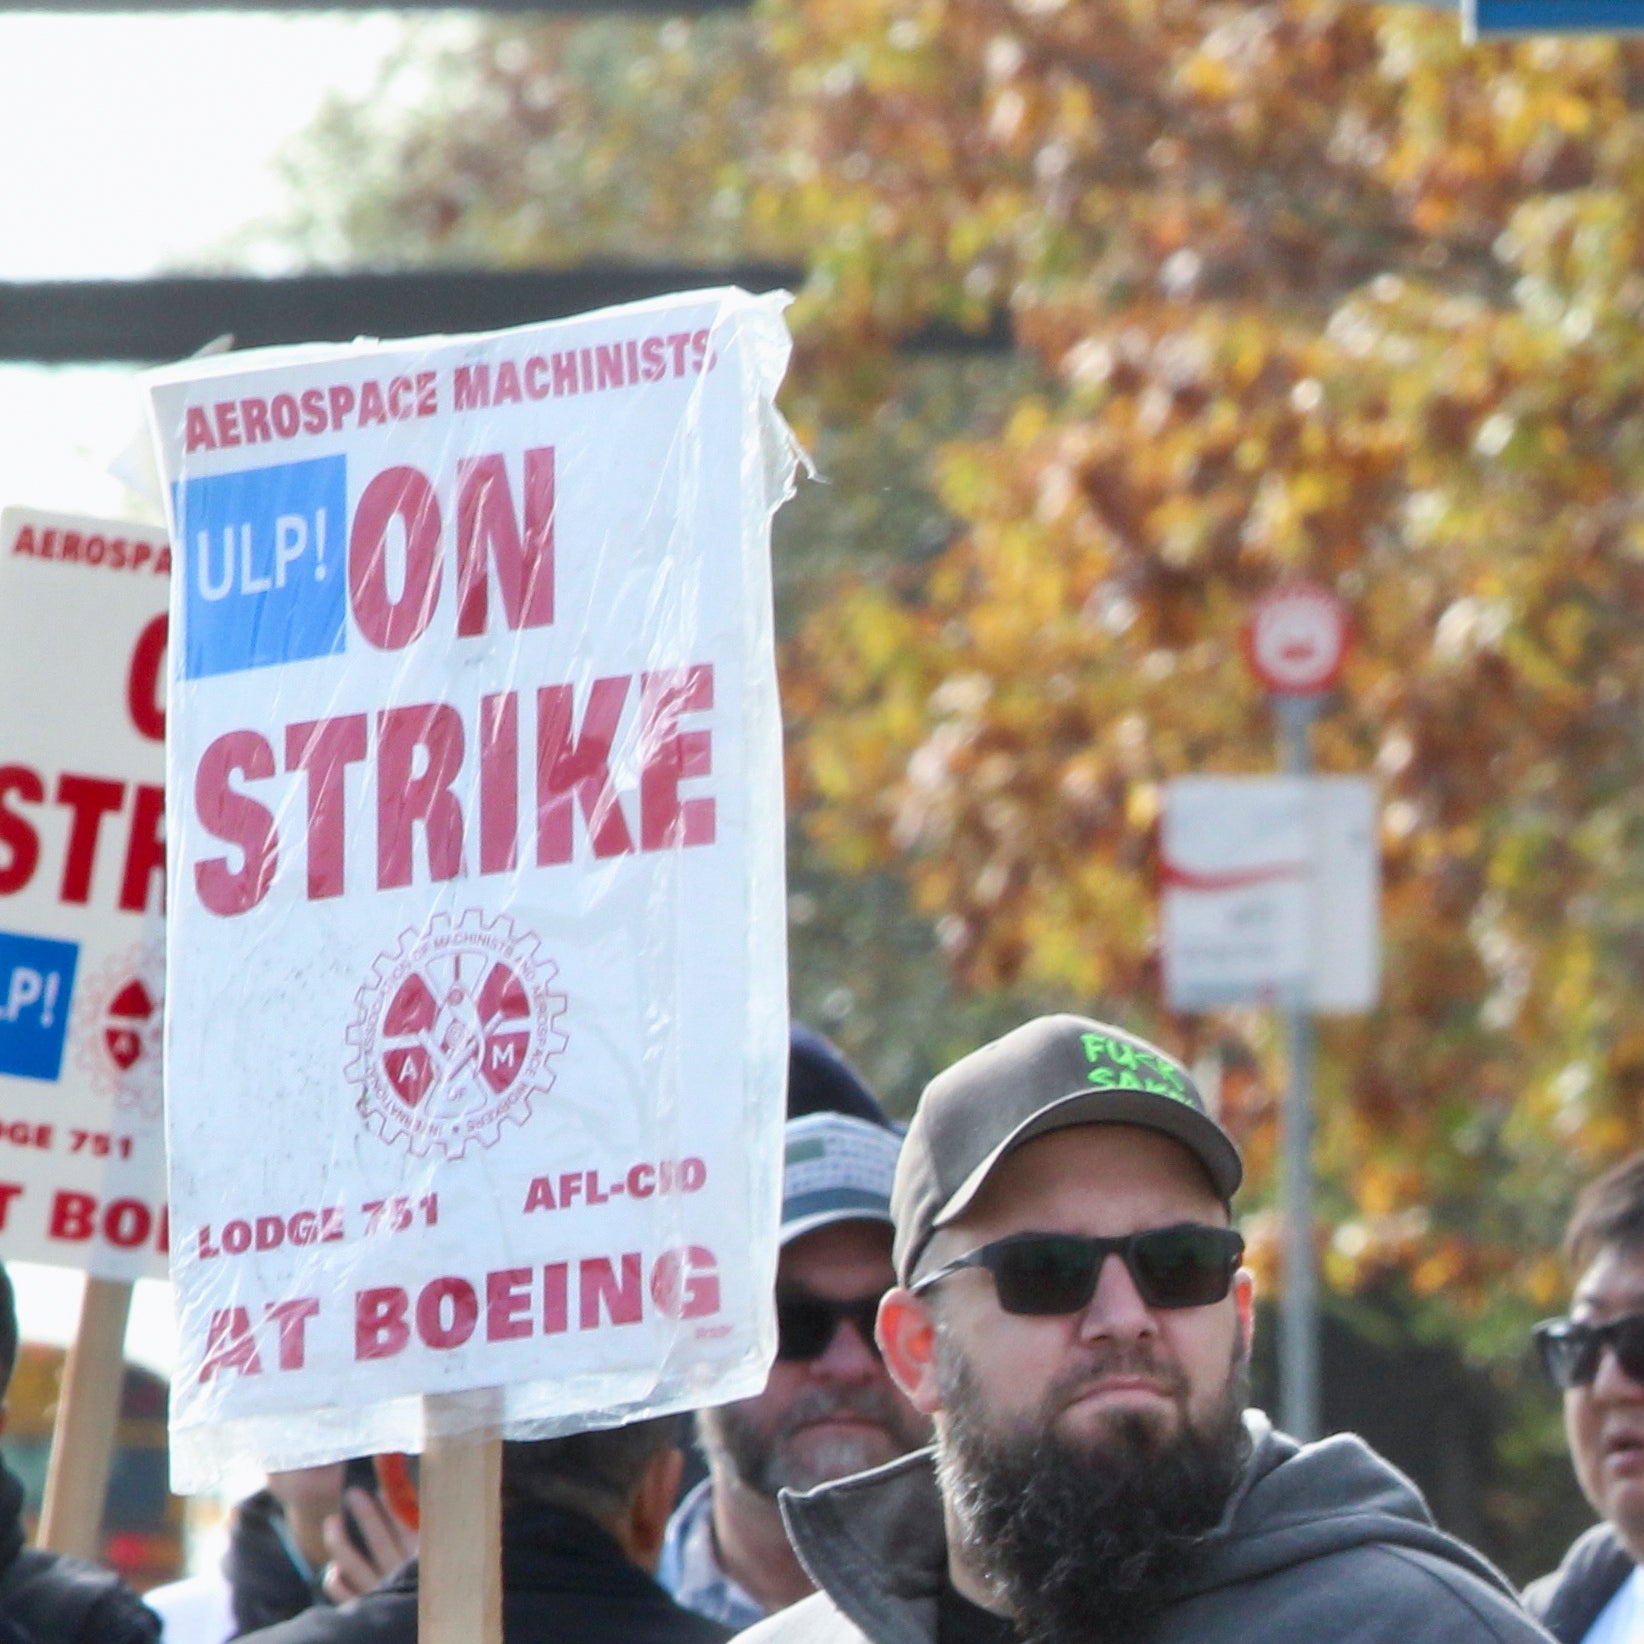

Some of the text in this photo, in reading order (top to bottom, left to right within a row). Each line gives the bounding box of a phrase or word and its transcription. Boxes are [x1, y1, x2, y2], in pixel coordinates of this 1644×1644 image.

[186, 329, 717, 453] AEROSPACE MACHINISTS
[200, 507, 329, 603] ULP!
[348, 446, 557, 652] ON
[193, 663, 716, 920] STRIKE
[200, 1206, 345, 1260] LODGE
[361, 1193, 438, 1237] 751
[522, 1157, 707, 1214] AFL-CIO
[199, 1245, 720, 1384] AT BOEING
